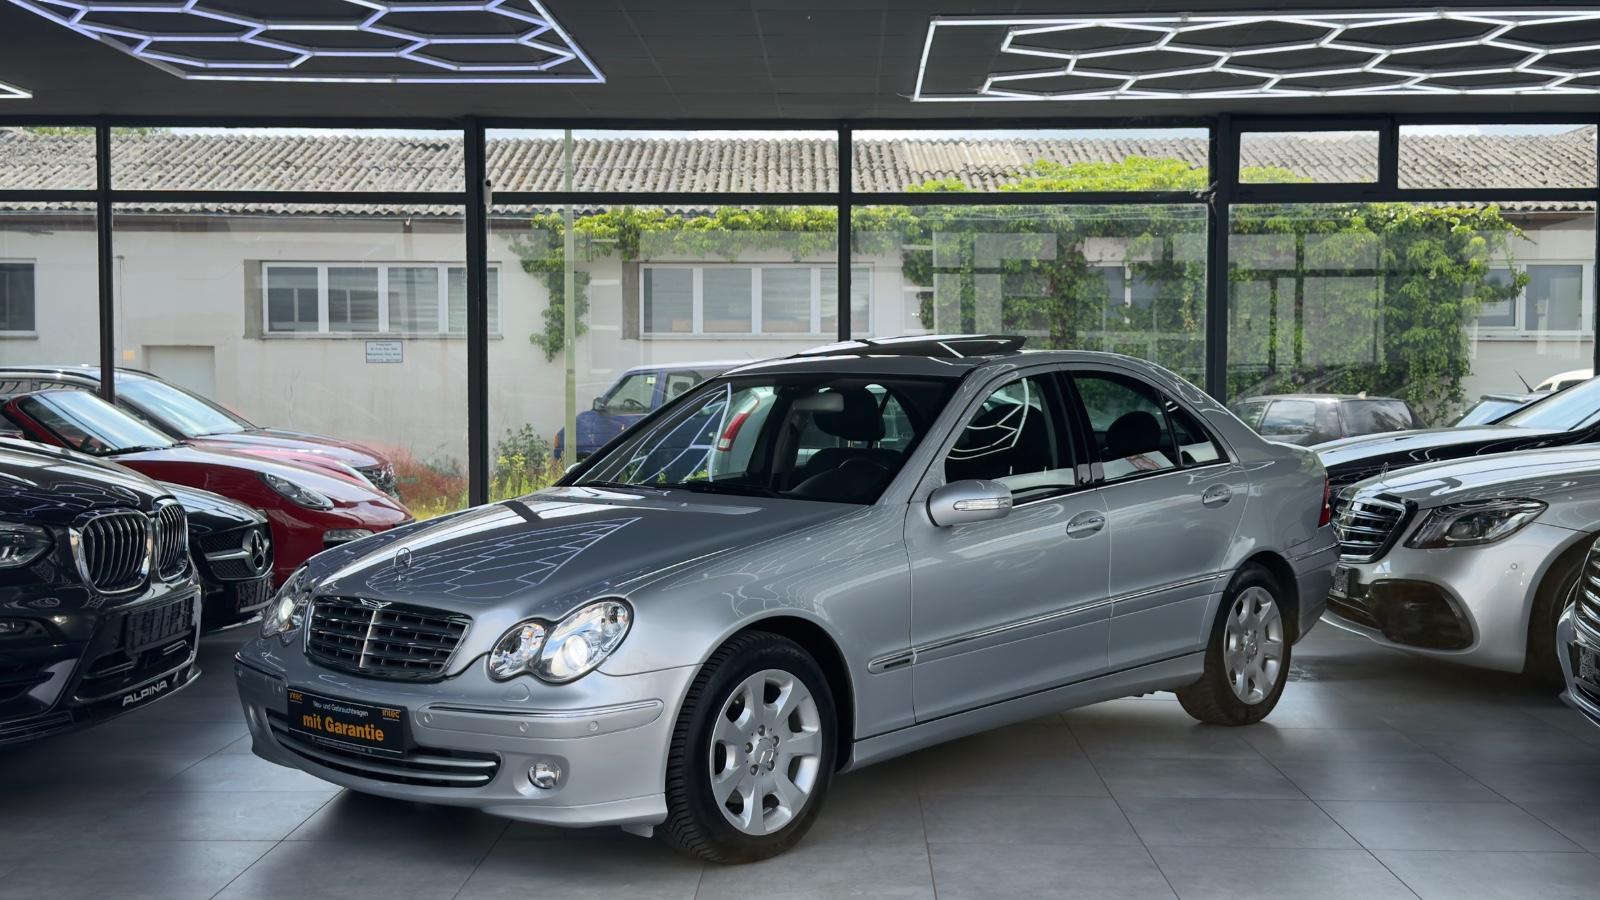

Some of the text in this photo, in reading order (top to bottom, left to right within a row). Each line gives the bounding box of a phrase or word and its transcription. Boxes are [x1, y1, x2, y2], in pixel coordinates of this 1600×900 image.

[122, 680, 168, 707] ALPINA
[331, 704, 368, 717] Gebrauchtwagen
[303, 714, 385, 742] mit Garantie
